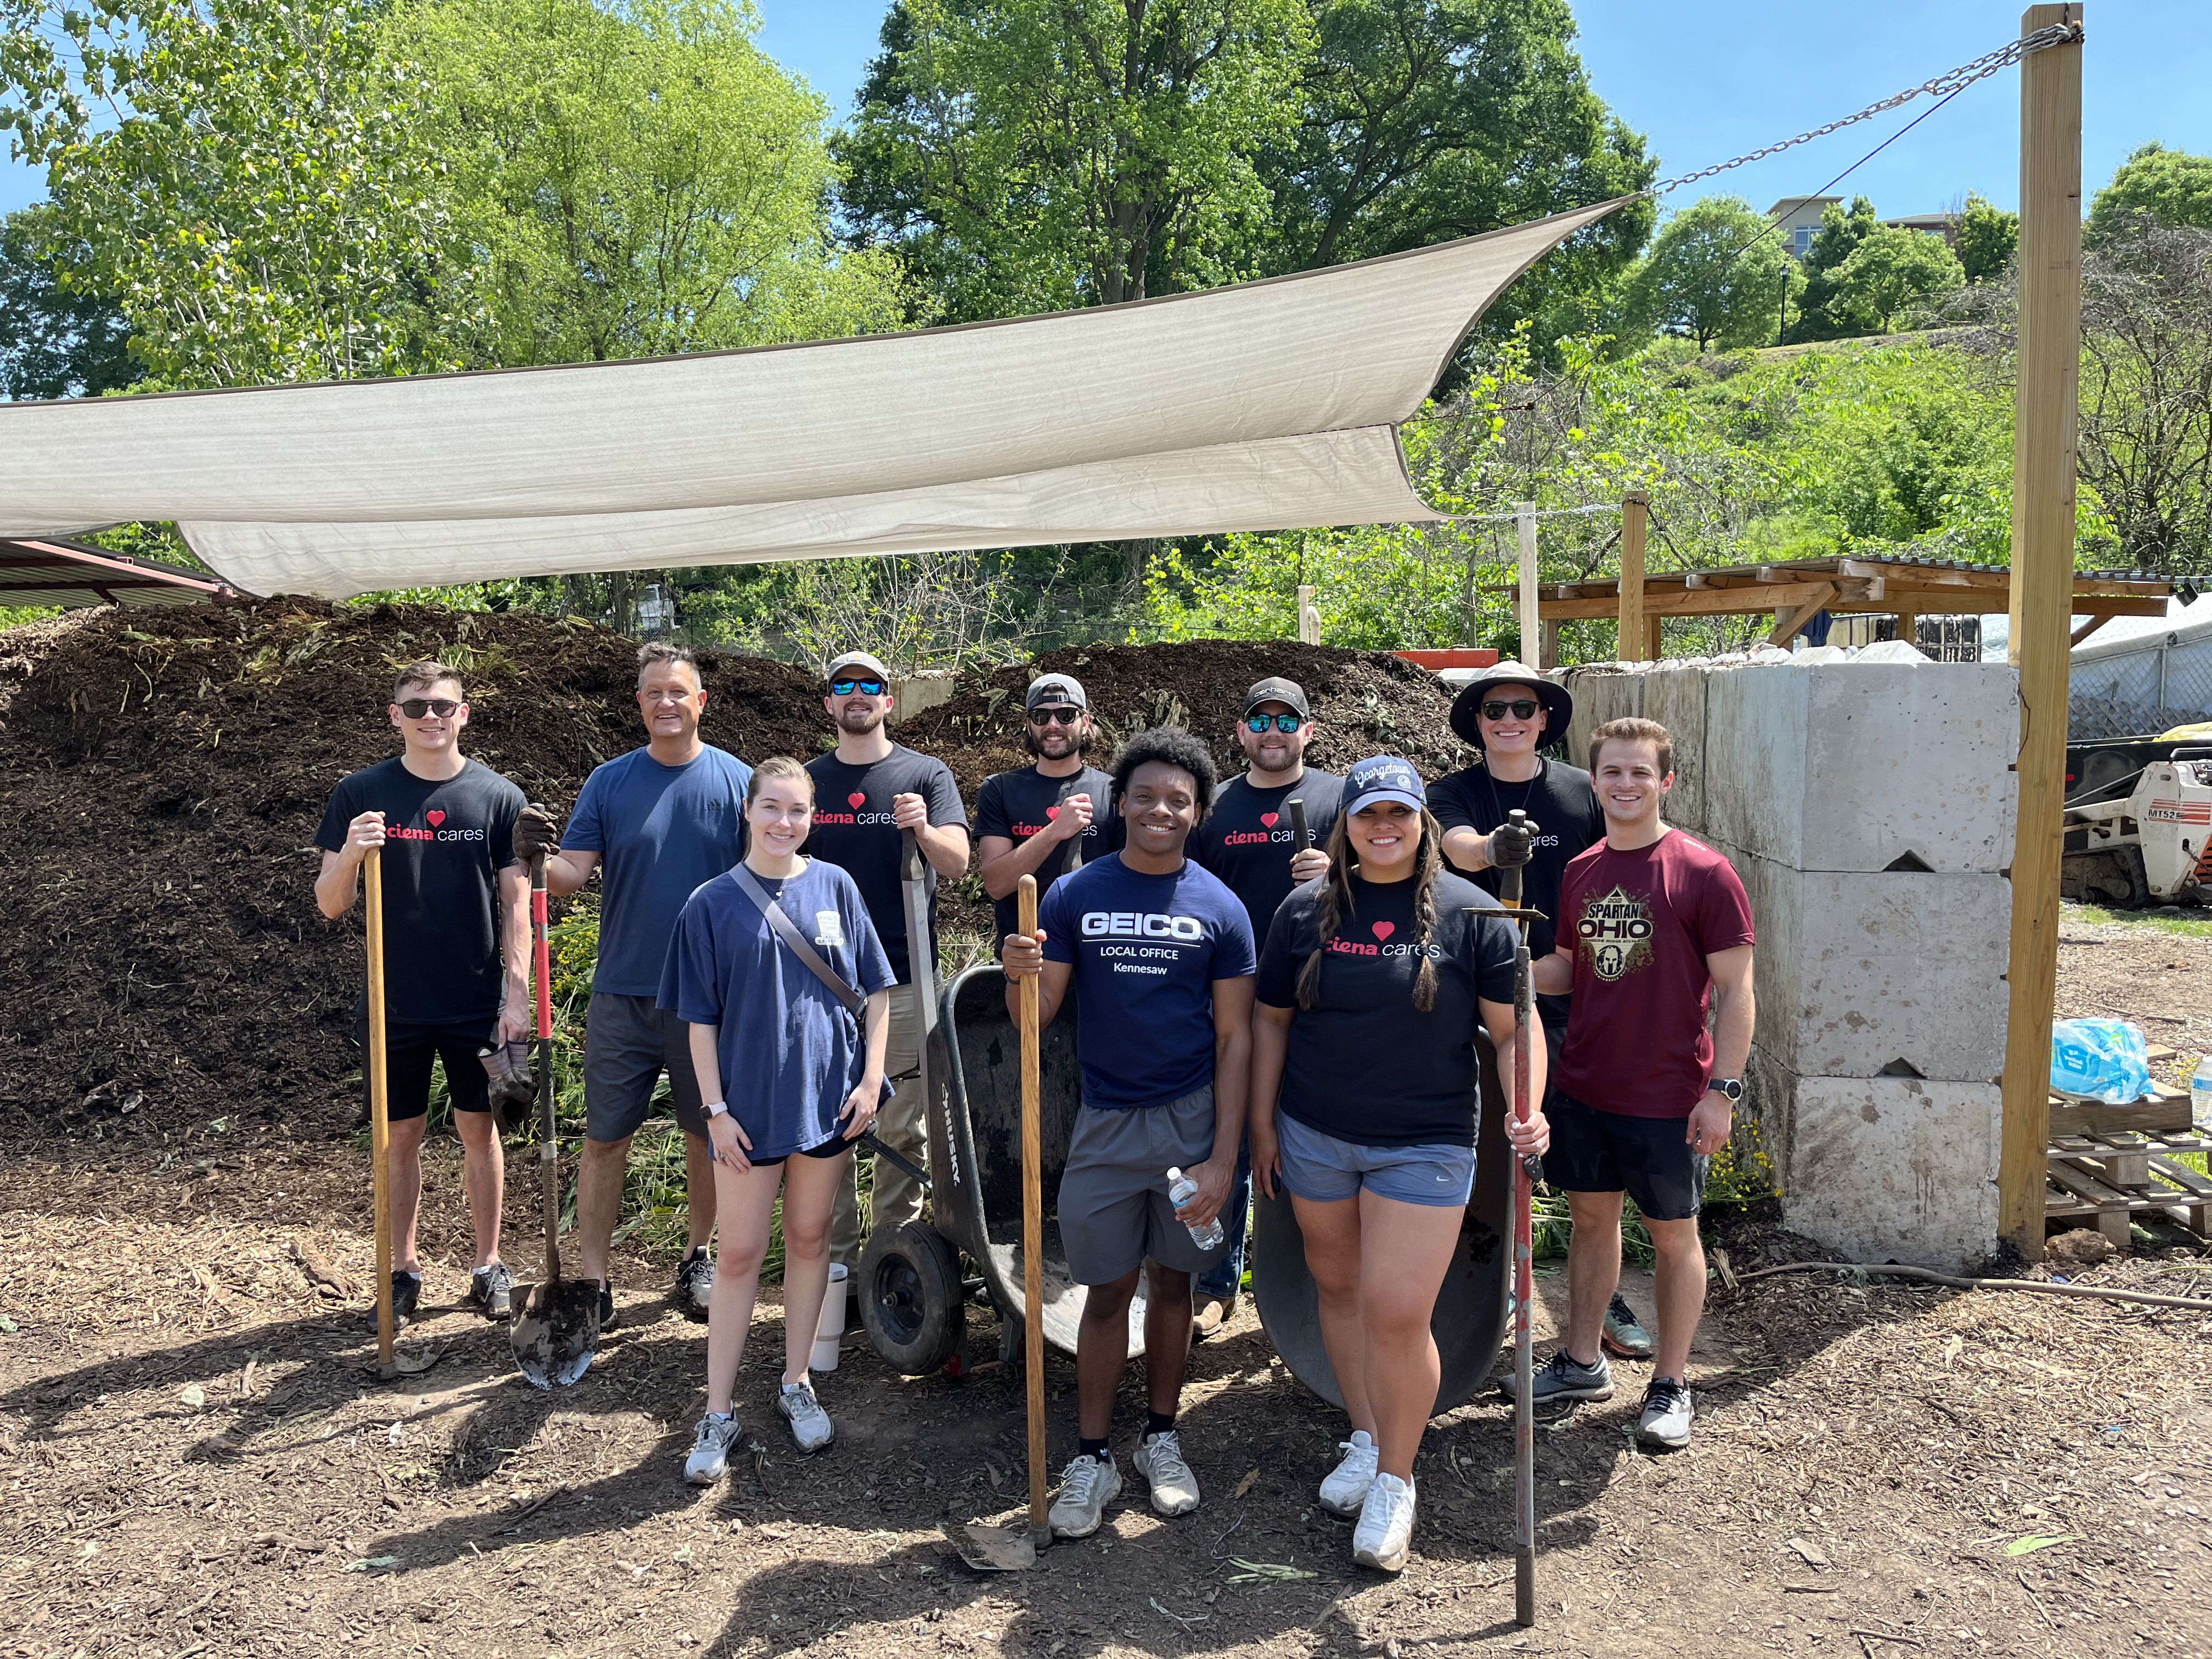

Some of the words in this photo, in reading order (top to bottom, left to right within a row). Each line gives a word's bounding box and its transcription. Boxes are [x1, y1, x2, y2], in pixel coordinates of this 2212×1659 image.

[1254, 687, 1296, 699] carhartt
[1355, 763, 1410, 788] Georgetown
[1397, 775, 1411, 789] G
[813, 809, 854, 825] ciena
[387, 823, 434, 840] ciena
[437, 829, 484, 841] cares
[1012, 821, 1043, 836] cien
[1224, 830, 1268, 845] ciena
[1271, 828, 1316, 843] cars
[1528, 836, 1558, 847] ares
[1588, 904, 1639, 919] SPARTAN
[1081, 912, 1201, 940] GEICO
[1578, 919, 1651, 938] OHIO
[1101, 946, 1137, 957] LOCAL
[1139, 947, 1179, 960] OFFICE
[1325, 936, 1378, 956] ciena
[1382, 943, 1440, 958] cares
[1114, 962, 1167, 975] Kennesaw
[944, 1108, 960, 1184] HUSKY
